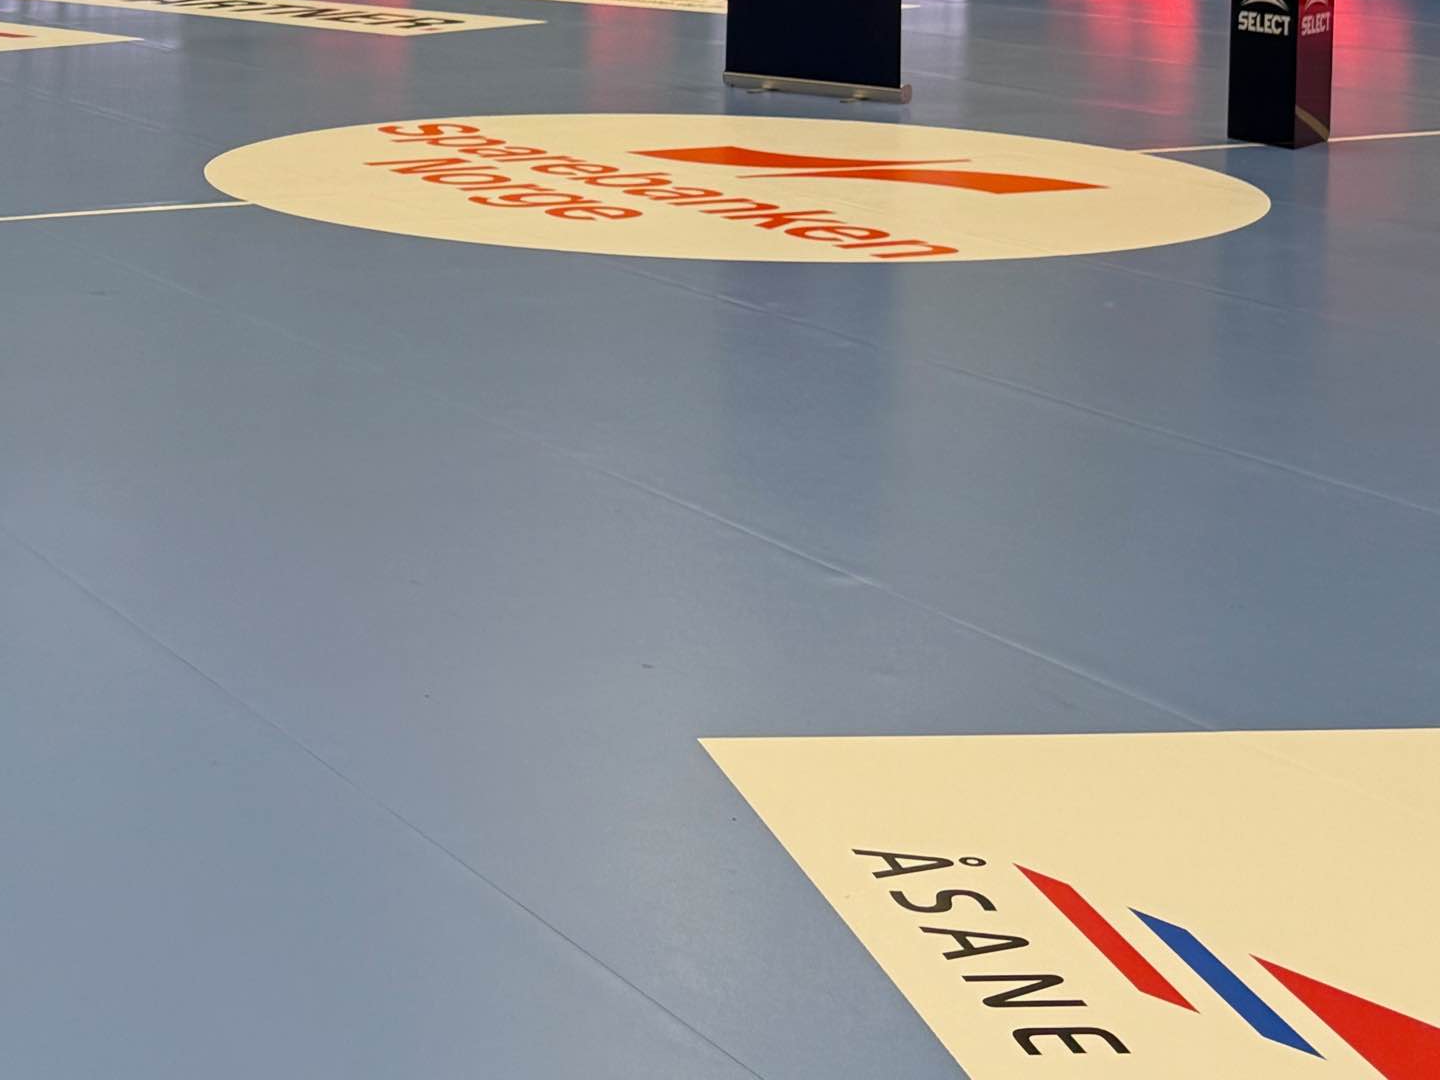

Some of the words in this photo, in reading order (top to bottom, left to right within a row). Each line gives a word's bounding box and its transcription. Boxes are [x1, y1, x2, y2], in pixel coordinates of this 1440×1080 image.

[1237, 10, 1291, 37] SELECT
[1301, 11, 1331, 37] SELECT
[362, 156, 643, 221] Norge
[376, 122, 960, 259] Sparebanken
[851, 848, 1132, 1056] ÅSANE
